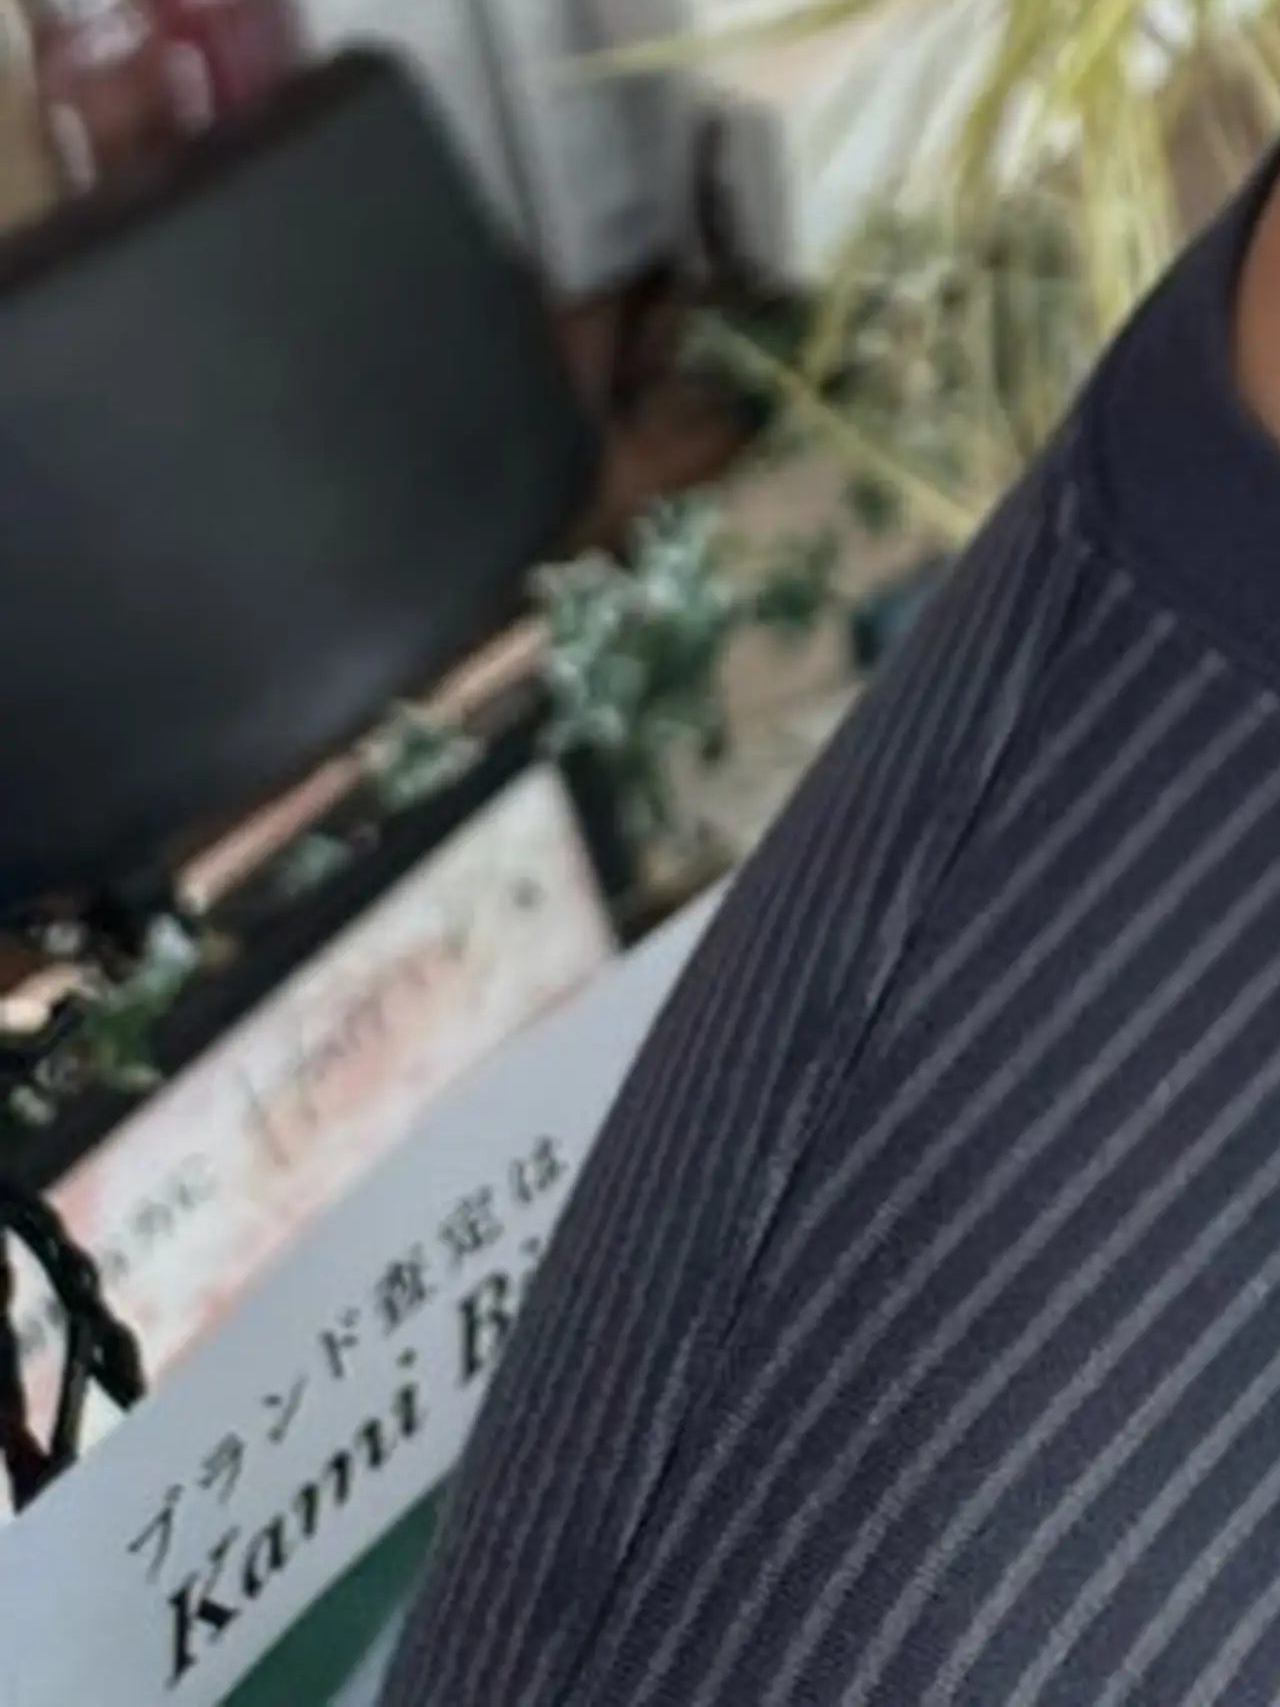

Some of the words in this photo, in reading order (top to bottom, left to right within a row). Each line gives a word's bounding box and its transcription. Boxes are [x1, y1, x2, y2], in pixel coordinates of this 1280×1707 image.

[127, 1132, 569, 1584] ブランド査定は
[163, 1345, 429, 1689] Kami
